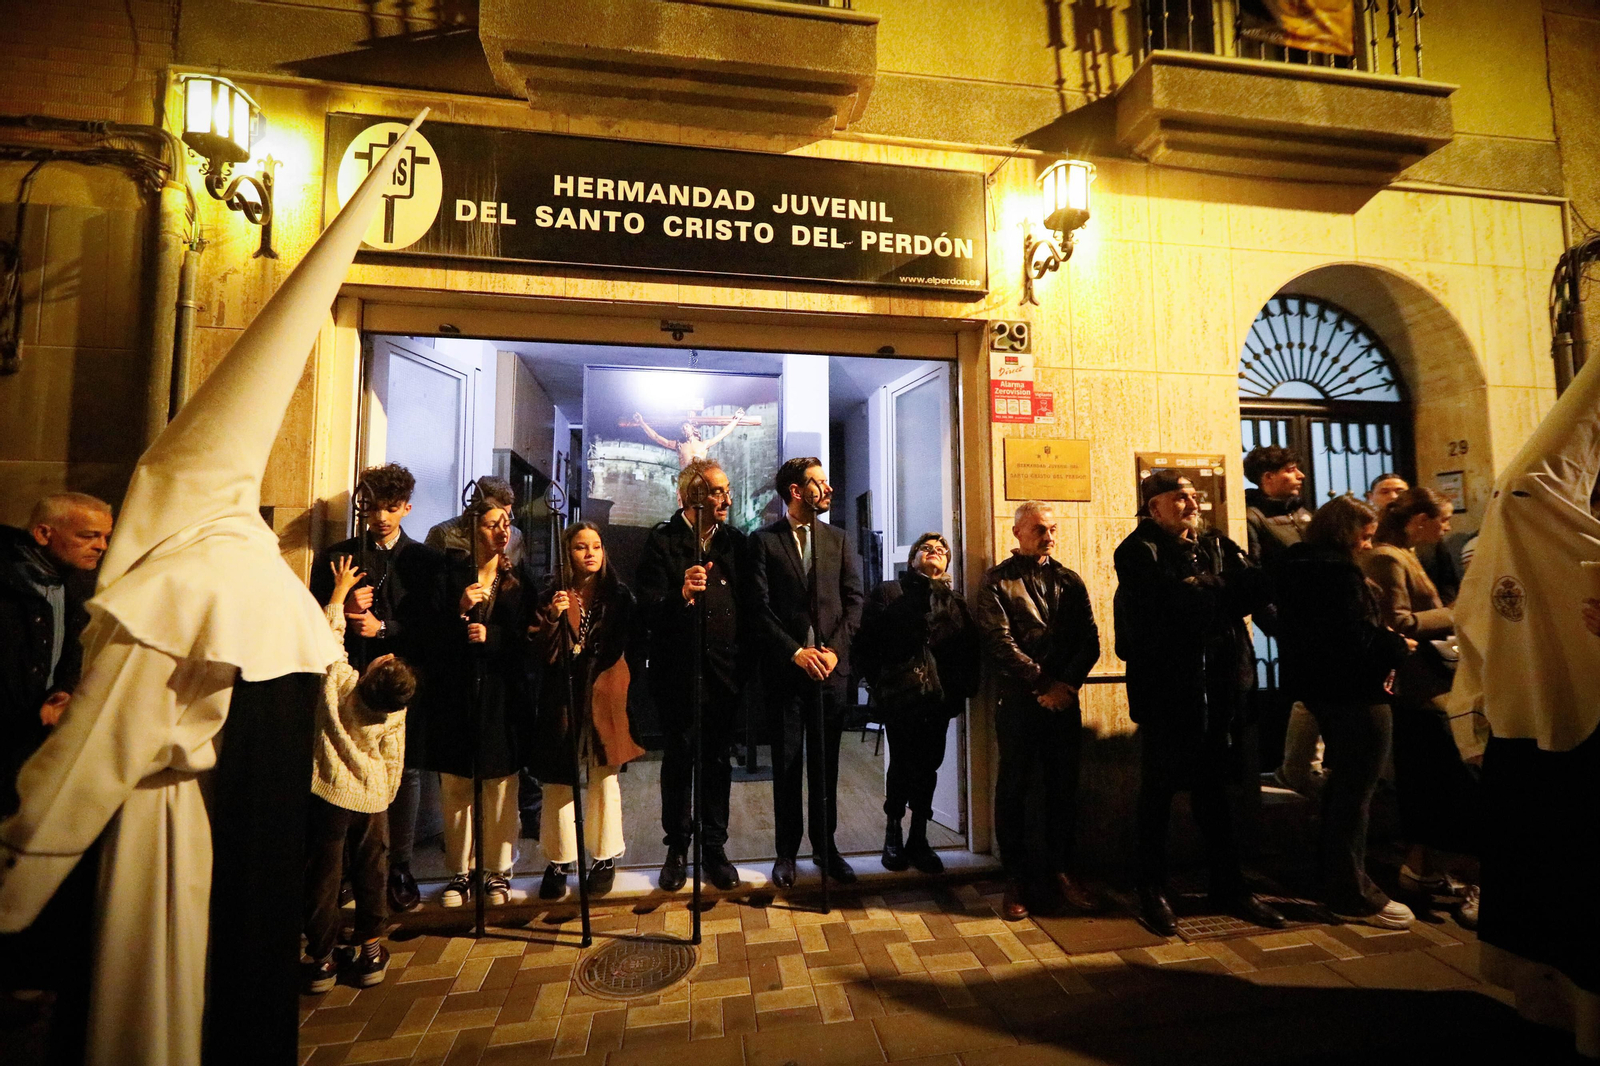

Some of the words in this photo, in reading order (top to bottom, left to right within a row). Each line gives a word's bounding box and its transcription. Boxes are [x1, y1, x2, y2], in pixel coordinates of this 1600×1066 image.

[553, 174, 755, 212] HERMANDAD
[772, 193, 894, 224] JUVENIL
[455, 199, 517, 226] DEL
[535, 205, 646, 236] SANTO
[663, 215, 774, 246] CRISTO
[791, 224, 846, 250] DEL
[861, 229, 974, 260] PERDÓN
[899, 276, 981, 287] www.elperdon.es
[994, 321, 1028, 350] 29
[1448, 440, 1469, 457] 29
